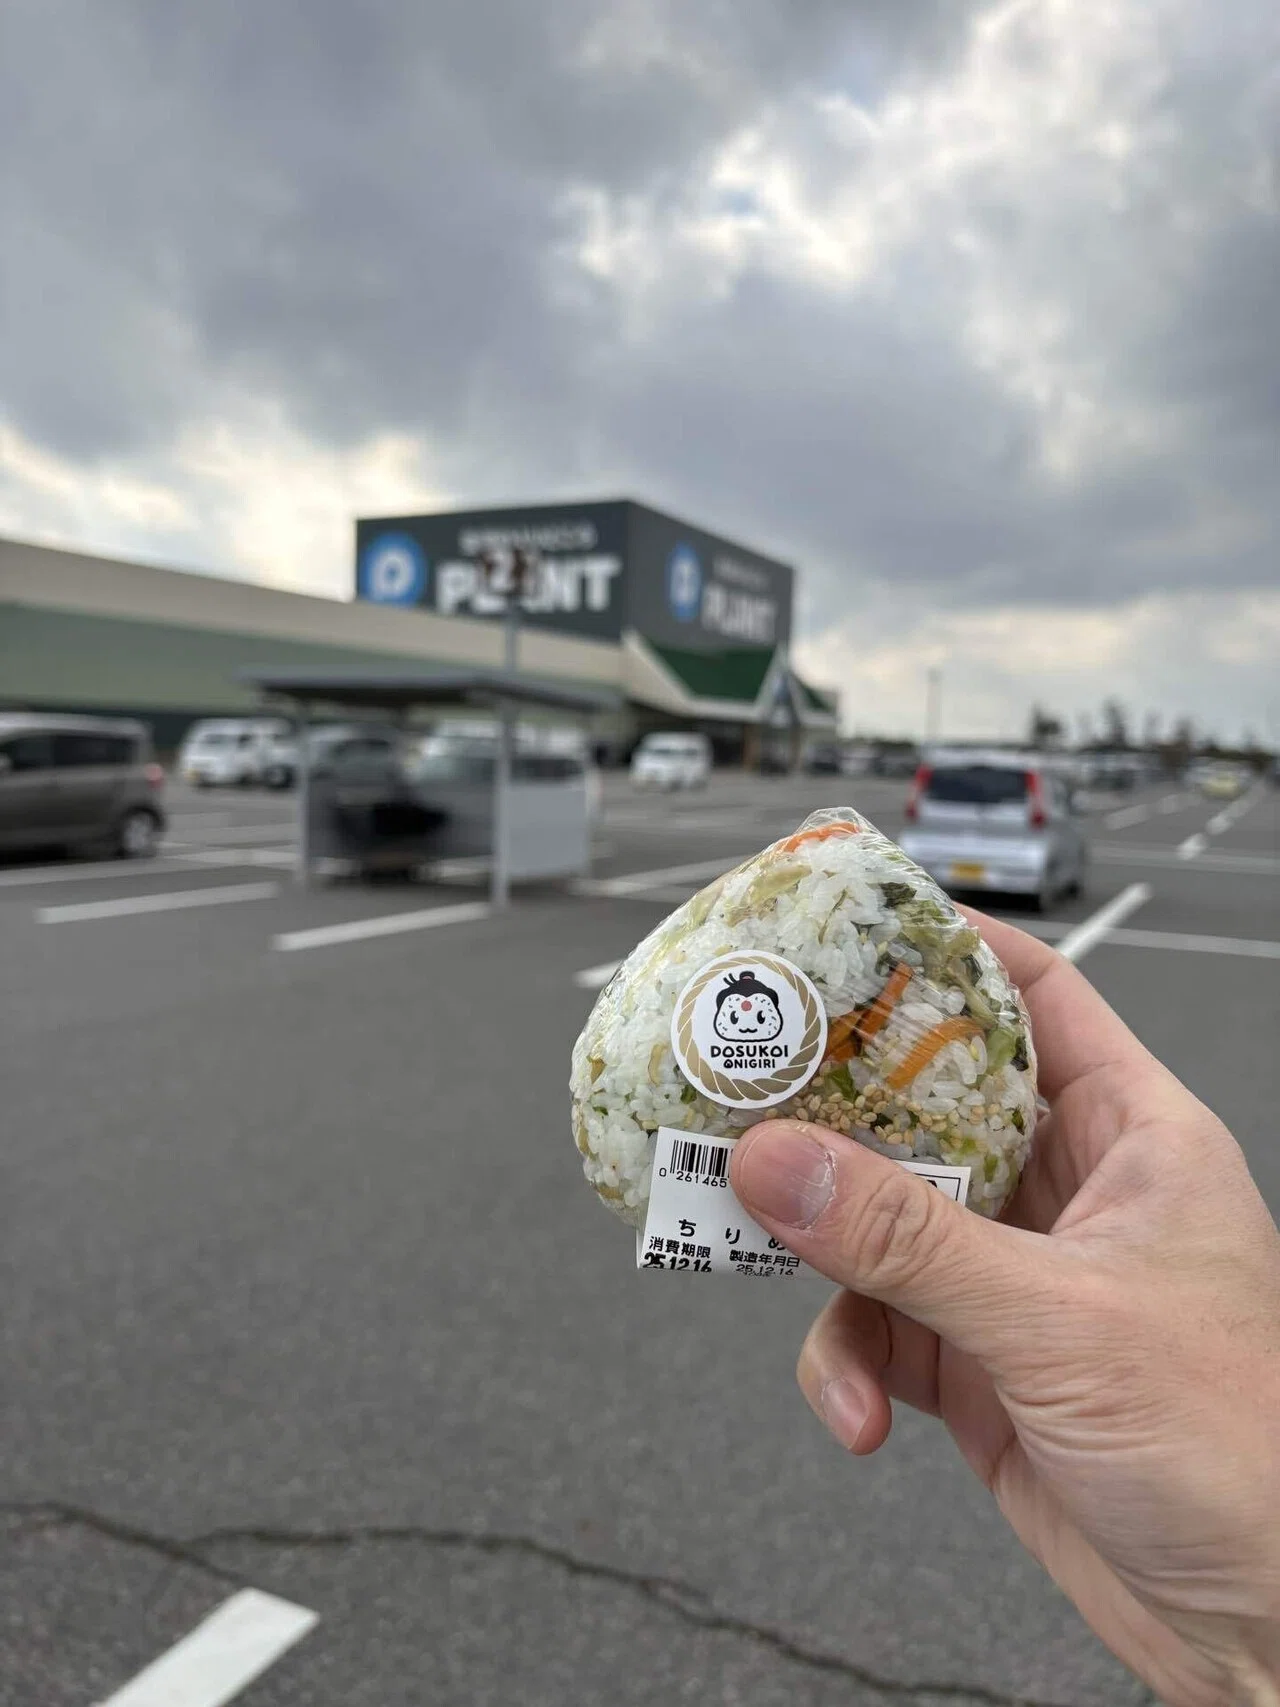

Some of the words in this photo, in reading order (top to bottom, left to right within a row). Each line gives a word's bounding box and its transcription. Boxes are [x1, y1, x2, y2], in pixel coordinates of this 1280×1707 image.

[710, 1045, 789, 1058] DOSUKOI
[723, 1059, 776, 1069] ONIGIRI
[658, 1167, 667, 1177] 0
[649, 1235, 712, 1259] 消費期限
[642, 1251, 713, 1273] 251216
[729, 1249, 801, 1268] 製造年月日
